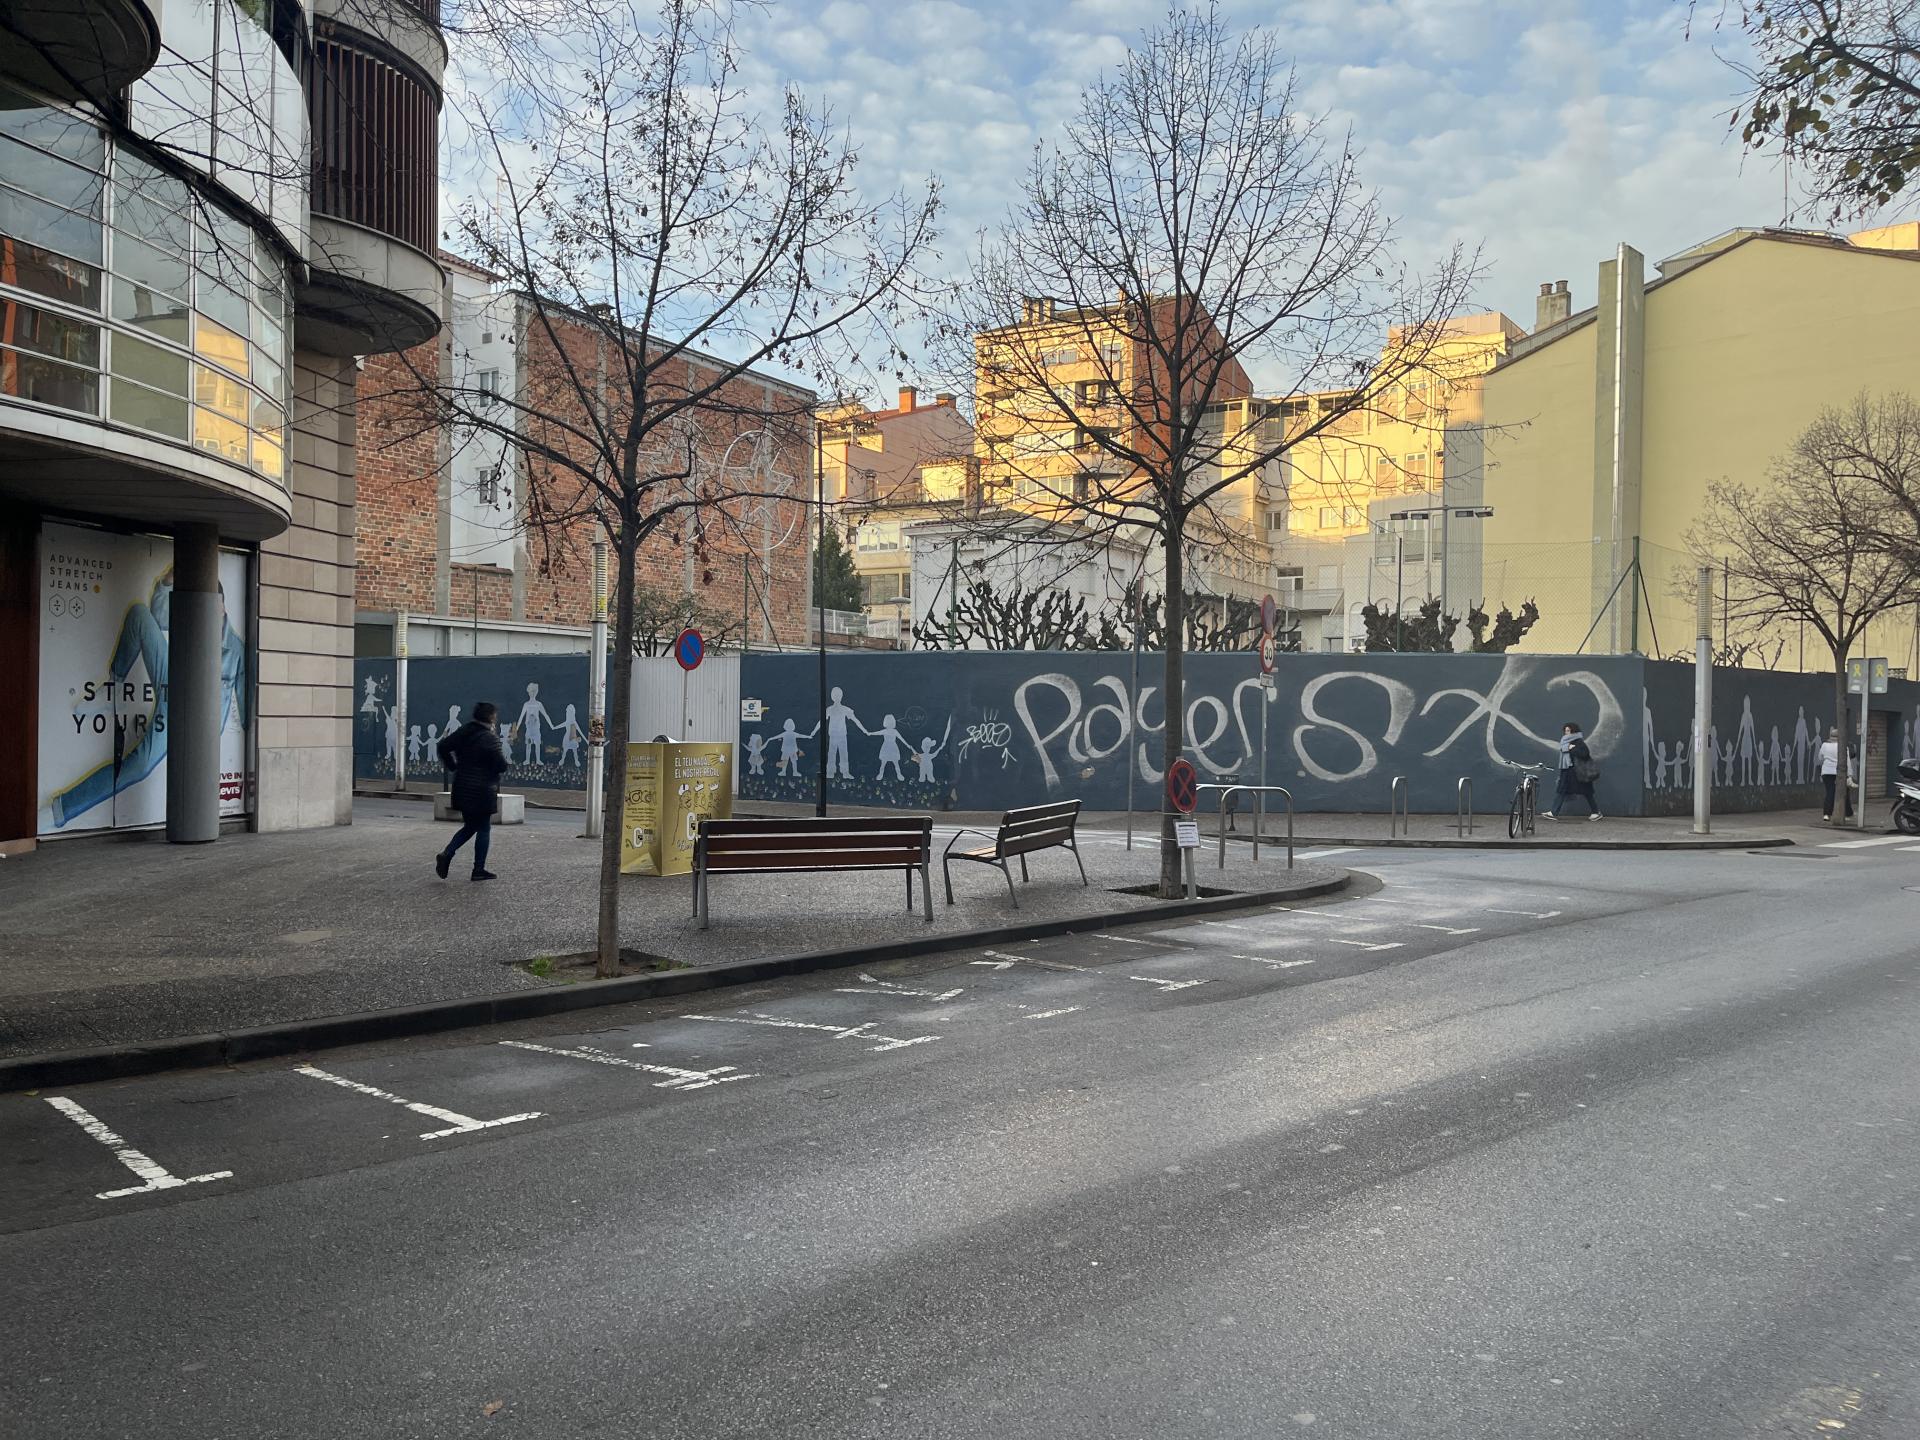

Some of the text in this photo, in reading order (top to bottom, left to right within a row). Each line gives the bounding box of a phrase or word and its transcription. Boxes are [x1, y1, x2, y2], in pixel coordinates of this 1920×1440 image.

[49, 553, 113, 570] ADVANCED
[49, 566, 103, 581] STRETCH
[49, 579, 88, 592] JEANS
[1264, 646, 1273, 661] 30
[72, 713, 165, 734] YOURS
[674, 757, 682, 767] EL
[674, 768, 681, 779] EL
